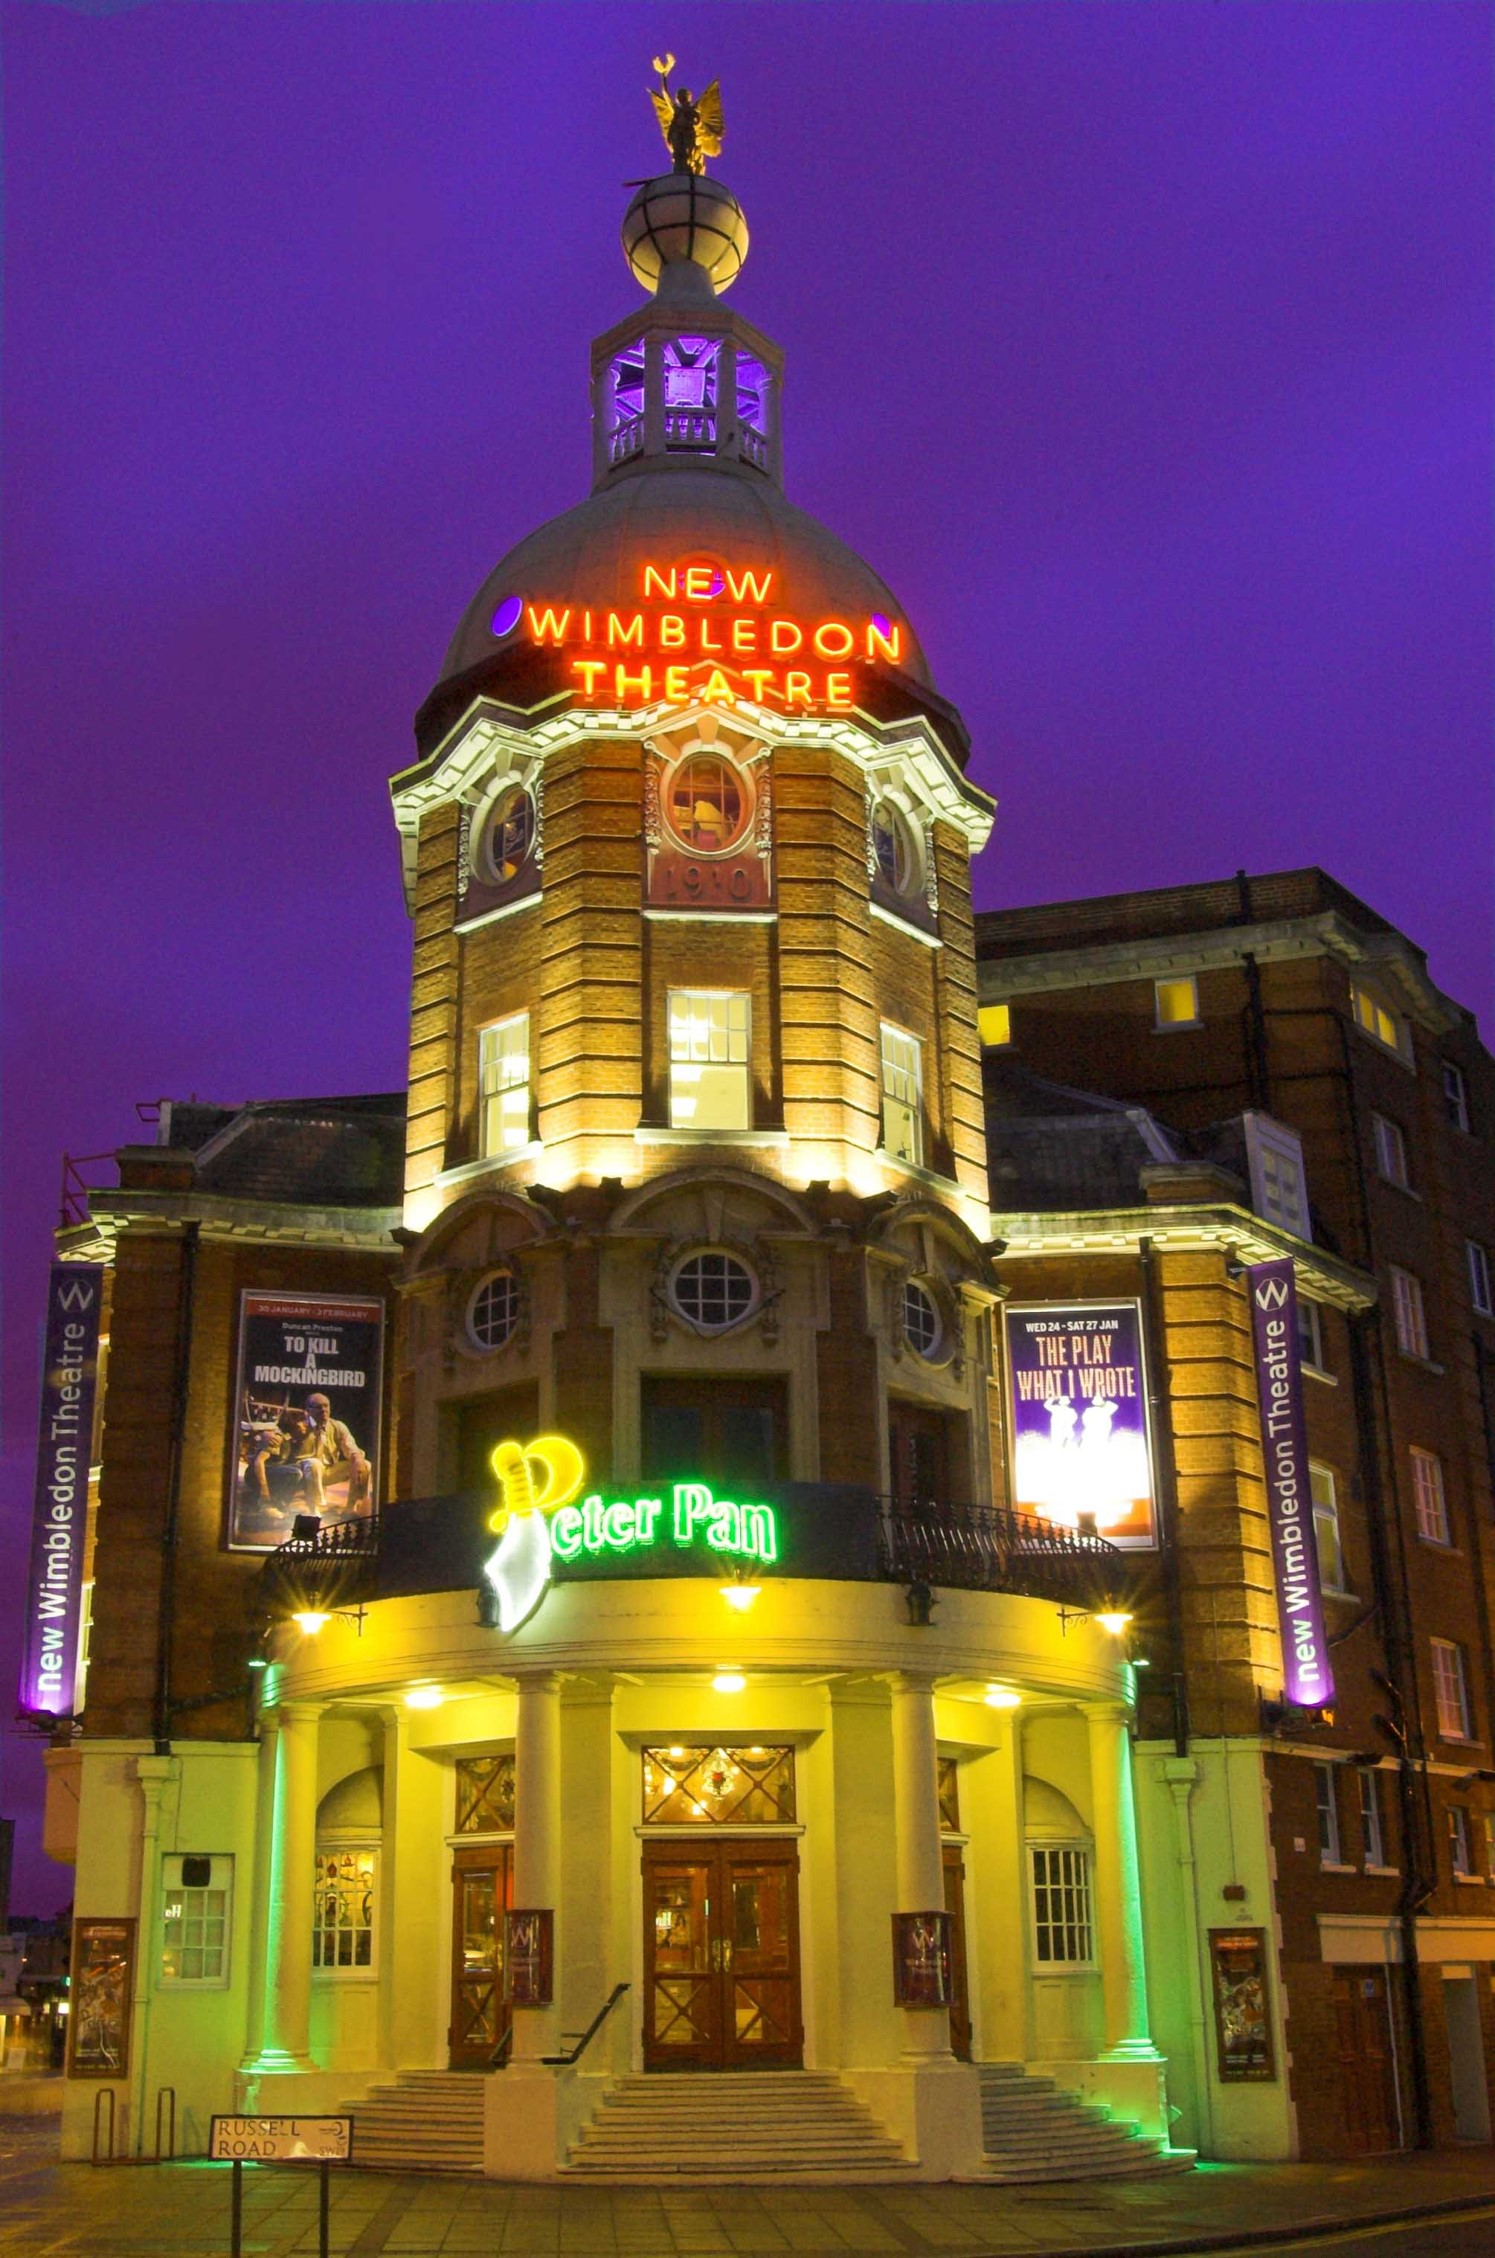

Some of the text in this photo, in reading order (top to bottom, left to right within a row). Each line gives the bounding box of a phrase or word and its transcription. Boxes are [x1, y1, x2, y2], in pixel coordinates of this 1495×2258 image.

[643, 565, 772, 602] NEW
[527, 606, 900, 659] WIMBLEDON
[572, 660, 852, 706] THEATRE
[270, 1305, 311, 1315] JANUARY
[323, 1309, 369, 1319] FEBRUARY
[1026, 1323, 1046, 1333] WED
[1048, 1322, 1060, 1332] 24
[1068, 1321, 1084, 1331] SAT
[1086, 1321, 1098, 1330] 27
[1099, 1320, 1119, 1330] JAN
[284, 1336, 339, 1355] TO KILL
[305, 1354, 316, 1369] A
[1036, 1335, 1112, 1367] THE PLAY
[255, 1365, 366, 1387] MOCKINGBIRD
[1017, 1367, 1136, 1401] WHAT I WROTE
[37, 1322, 85, 1692] new Wimbledon Theatre
[1263, 1320, 1320, 1683] new Wimbledon Theatre
[673, 1483, 778, 1561] Pan
[218, 2120, 300, 2137] RUSSELL
[218, 2140, 276, 2156] ROAD
